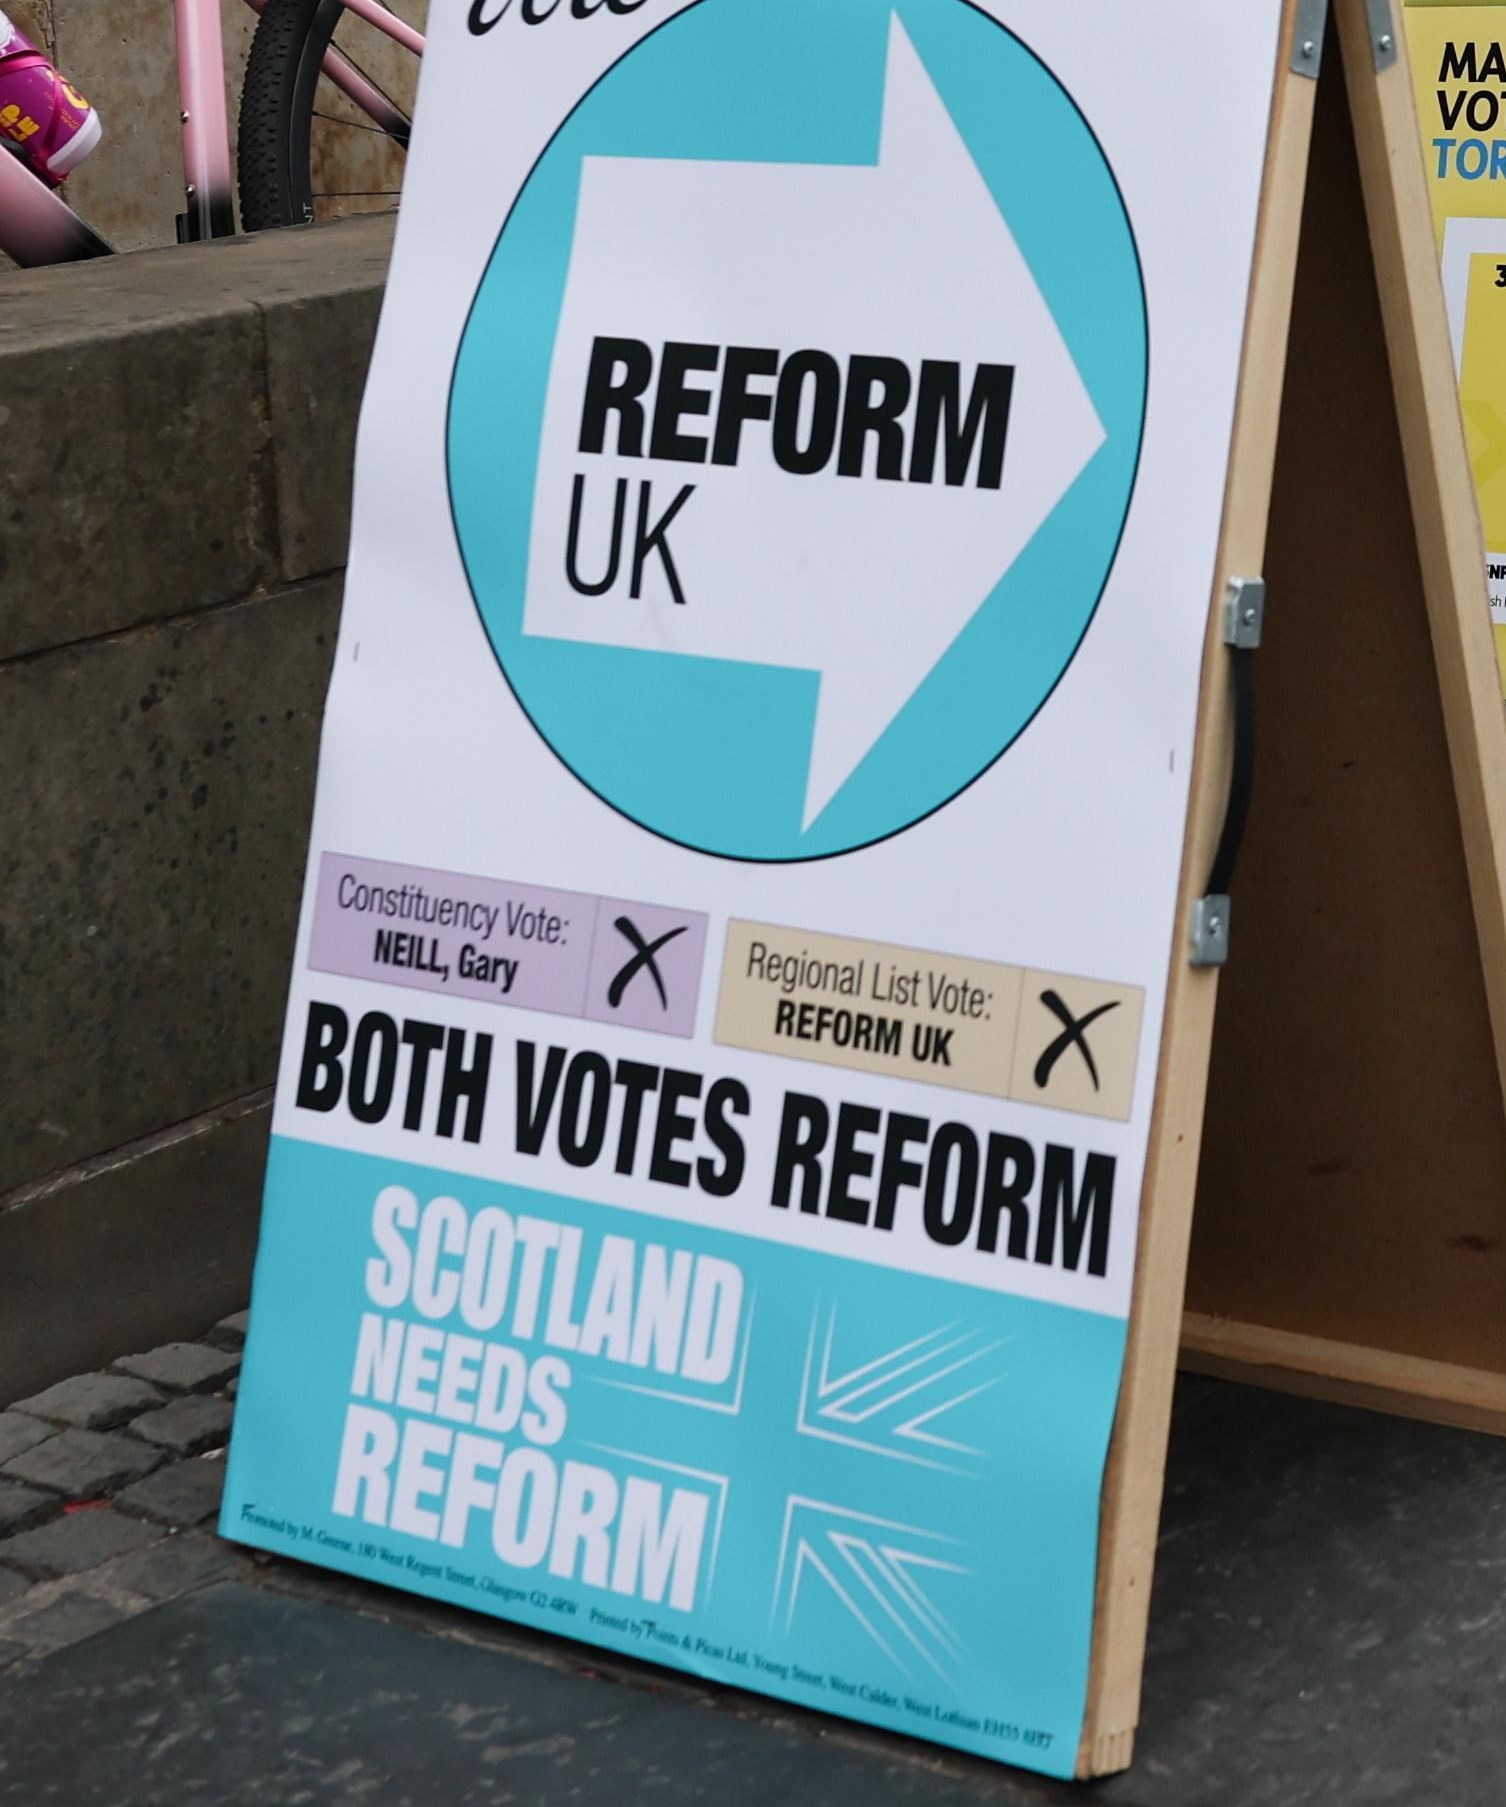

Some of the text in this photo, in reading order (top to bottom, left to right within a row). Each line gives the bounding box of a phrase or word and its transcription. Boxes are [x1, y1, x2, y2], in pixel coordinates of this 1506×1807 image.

[577, 336, 1015, 492] REFORM
[564, 473, 698, 605] UK
[337, 873, 571, 947] Constituency Vote:
[373, 929, 519, 993] NEILL, Gary
[748, 941, 993, 1020] Regional List Vote:
[774, 1000, 955, 1068] REFORM UK
[295, 1001, 1118, 1279] BOTH VOTES REFORM
[364, 1186, 745, 1386] SCOTLAND
[350, 1313, 572, 1447] NEEDS
[332, 1403, 710, 1614] REFORM
